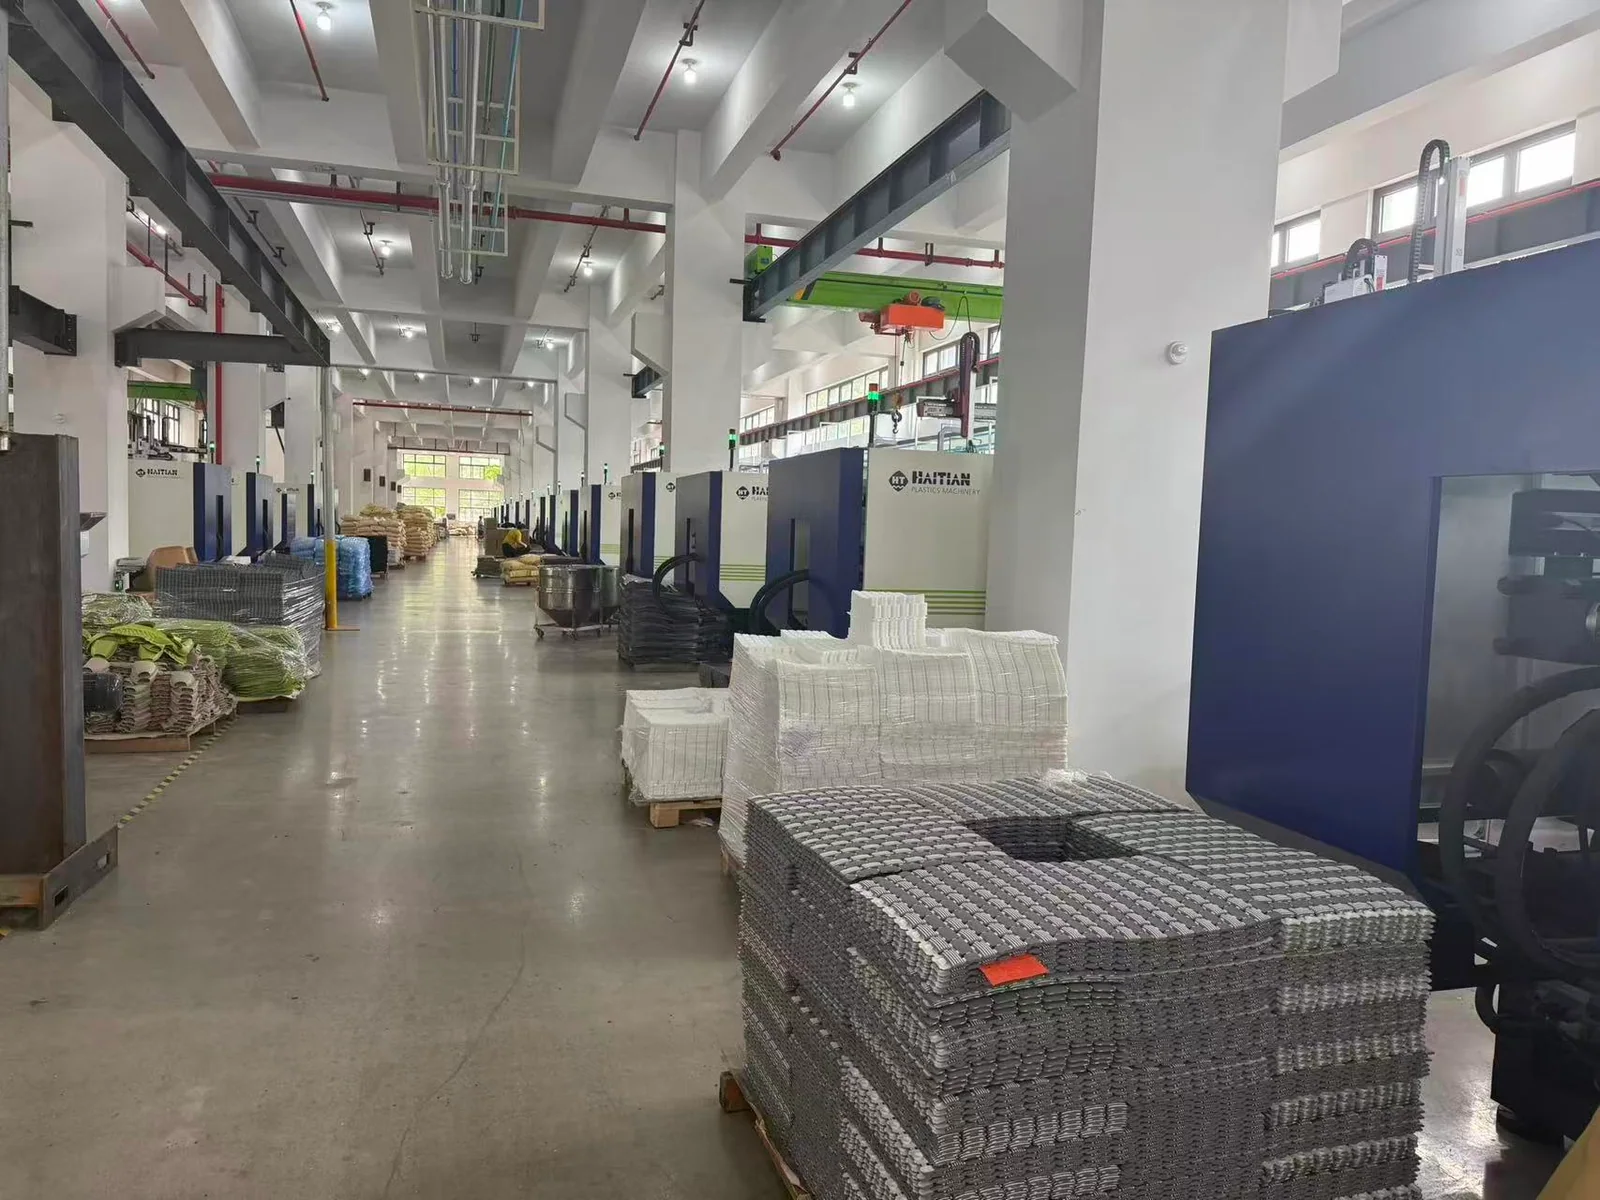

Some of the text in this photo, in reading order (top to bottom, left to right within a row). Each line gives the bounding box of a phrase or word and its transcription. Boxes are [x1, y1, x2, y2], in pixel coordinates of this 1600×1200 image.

[911, 470, 971, 486] HAITIAN
[911, 486, 980, 496] PLASTICS MACHINERY
